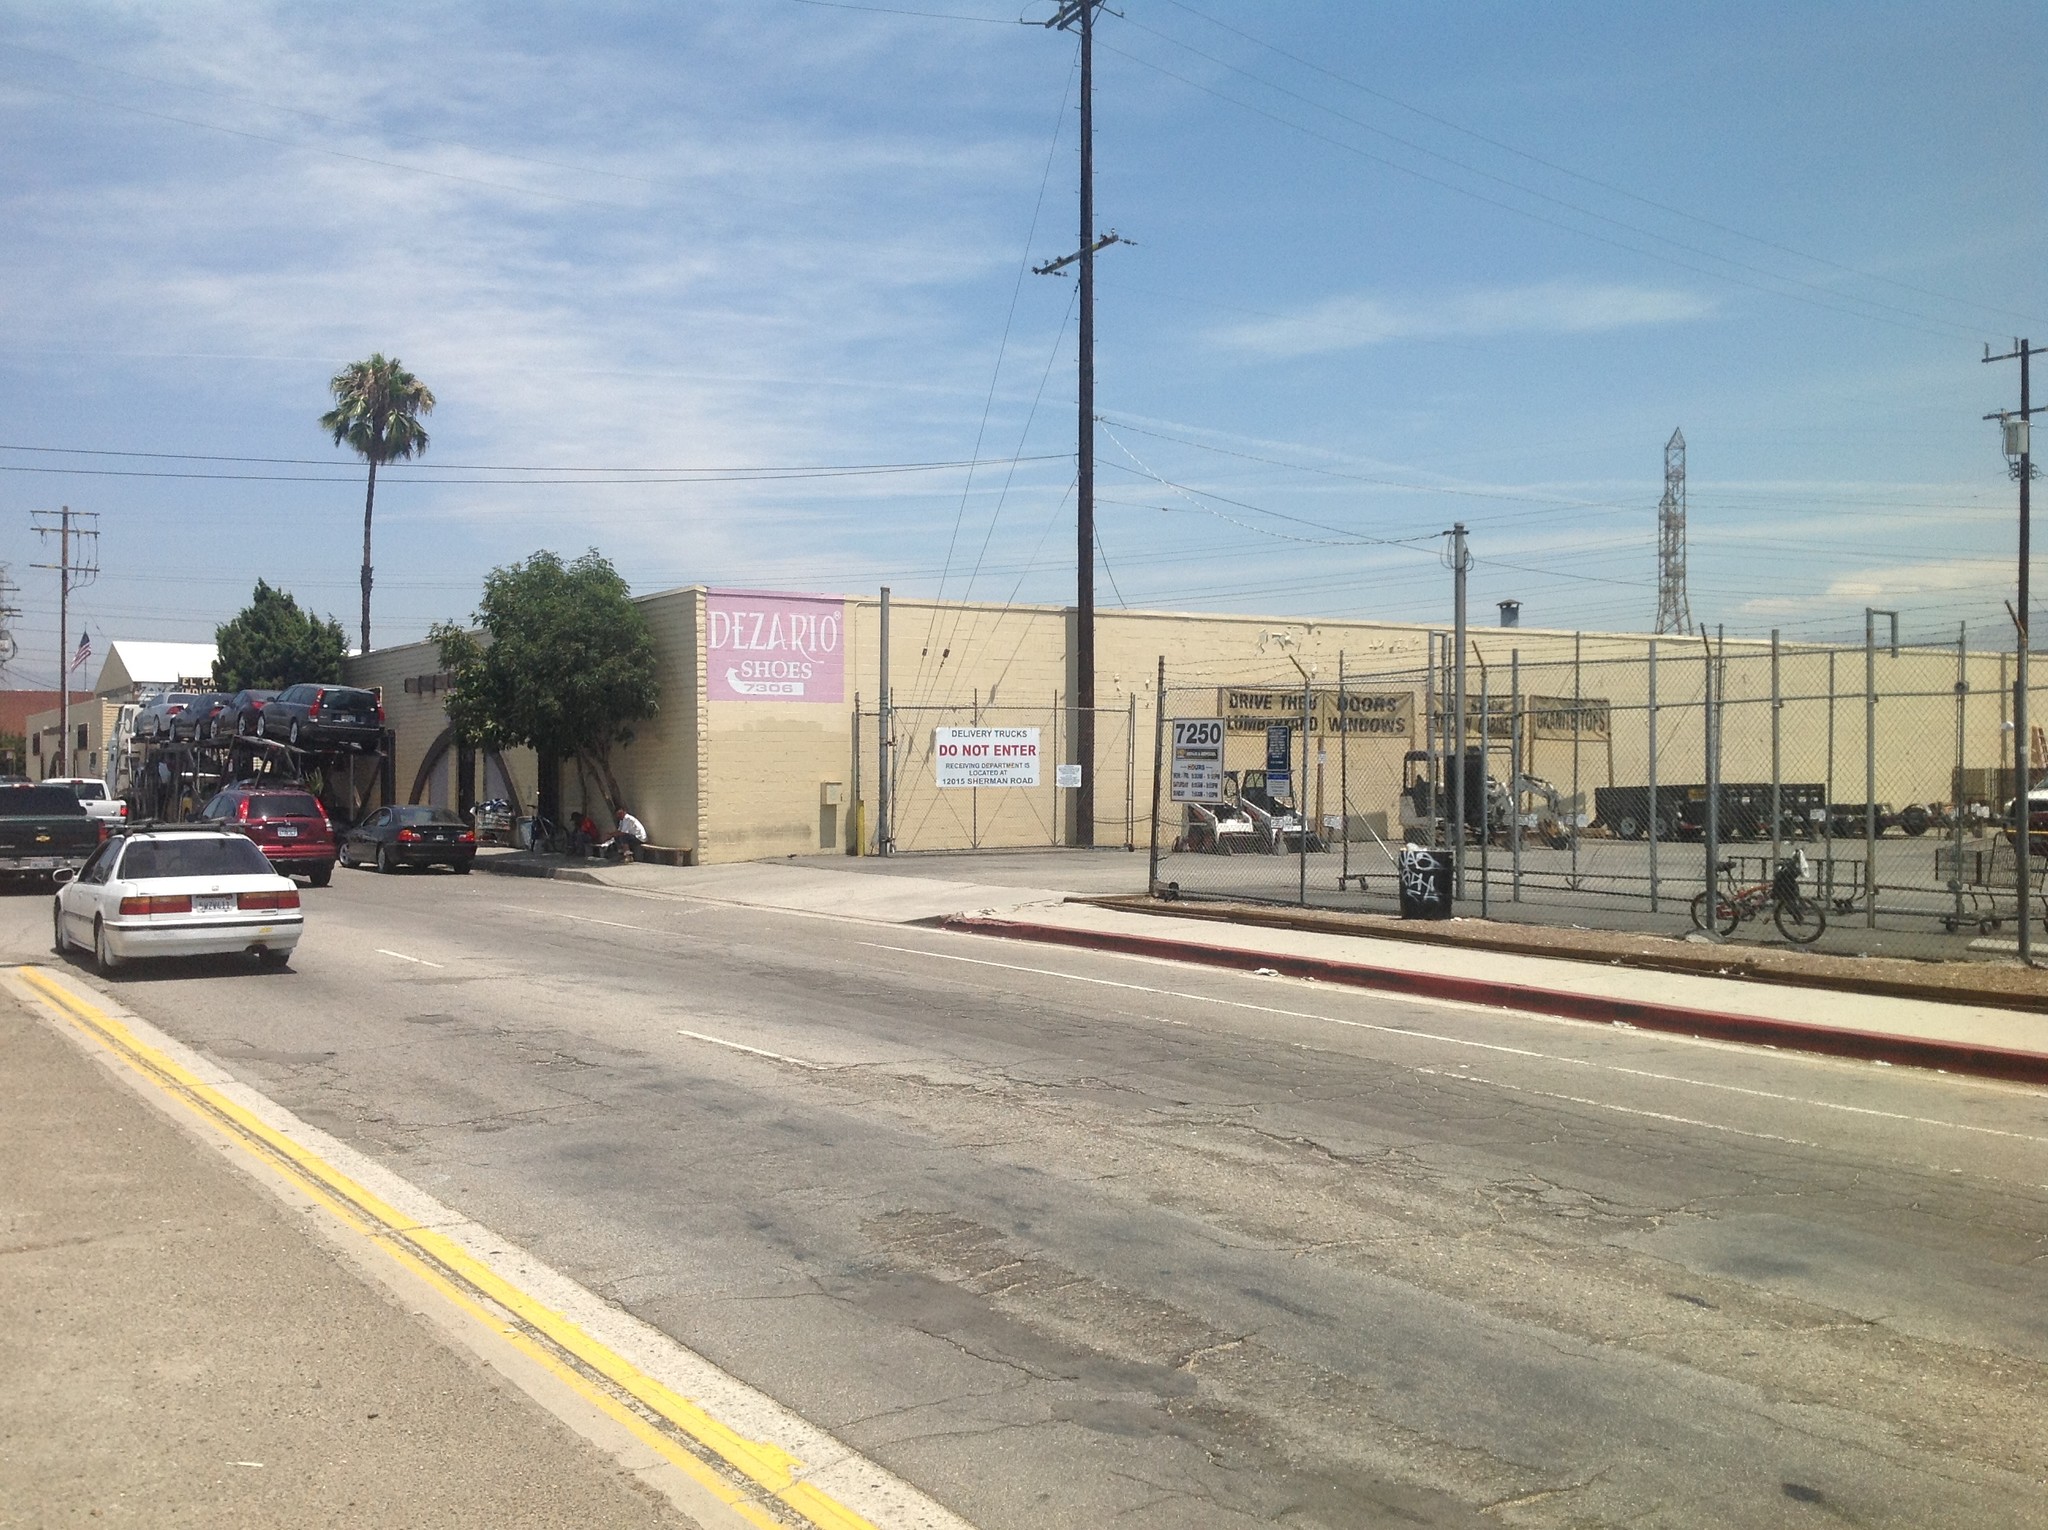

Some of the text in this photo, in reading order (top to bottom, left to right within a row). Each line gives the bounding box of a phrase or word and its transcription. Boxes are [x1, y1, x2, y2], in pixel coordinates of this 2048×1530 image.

[741, 660, 812, 679] SHOES
[182, 677, 196, 686] EL
[743, 684, 793, 693] 7306
[1229, 693, 1272, 709] DRIVE
[1337, 697, 1396, 712] DOORS
[1328, 717, 1405, 733] WINDOWS
[951, 730, 1028, 738] DELIVERY TRUCKS
[1176, 723, 1221, 744] 7250
[939, 745, 1037, 756] DO NOT ENTER
